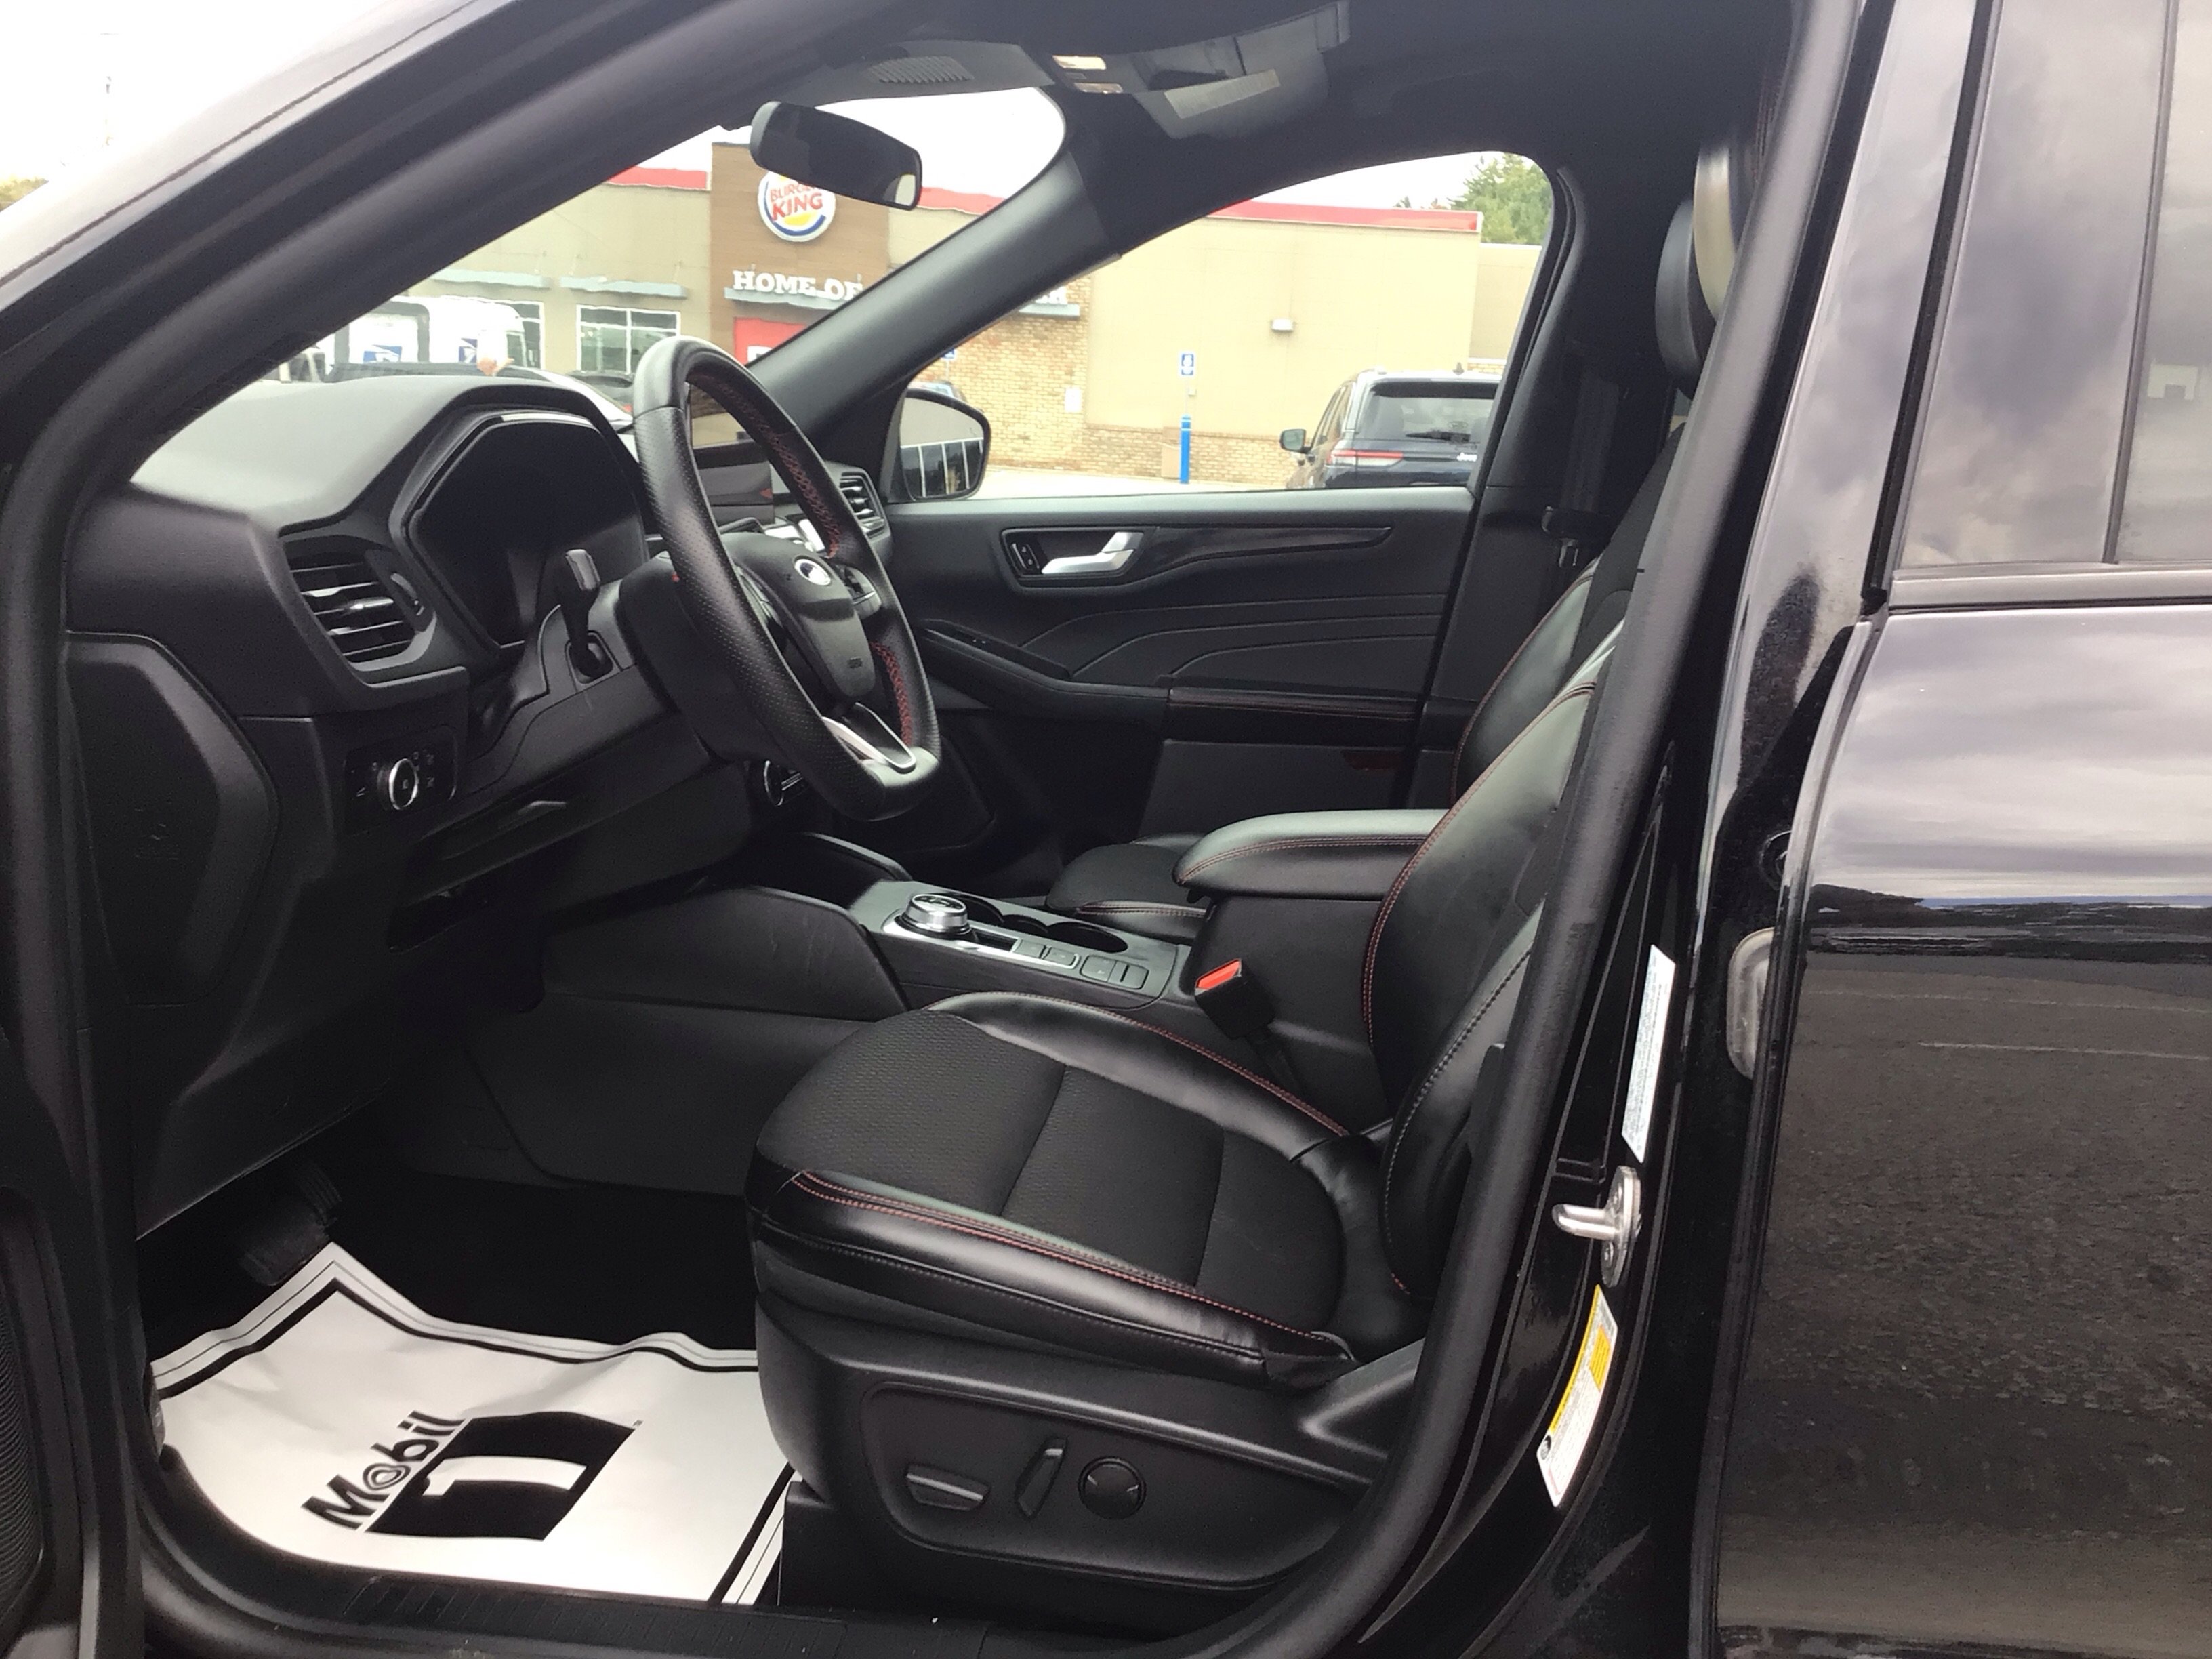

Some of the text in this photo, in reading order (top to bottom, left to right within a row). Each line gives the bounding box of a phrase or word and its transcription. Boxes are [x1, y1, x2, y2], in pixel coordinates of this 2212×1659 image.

[771, 192, 823, 221] KING
[733, 270, 863, 301] HOME OF
[300, 1410, 467, 1530] Mobil
